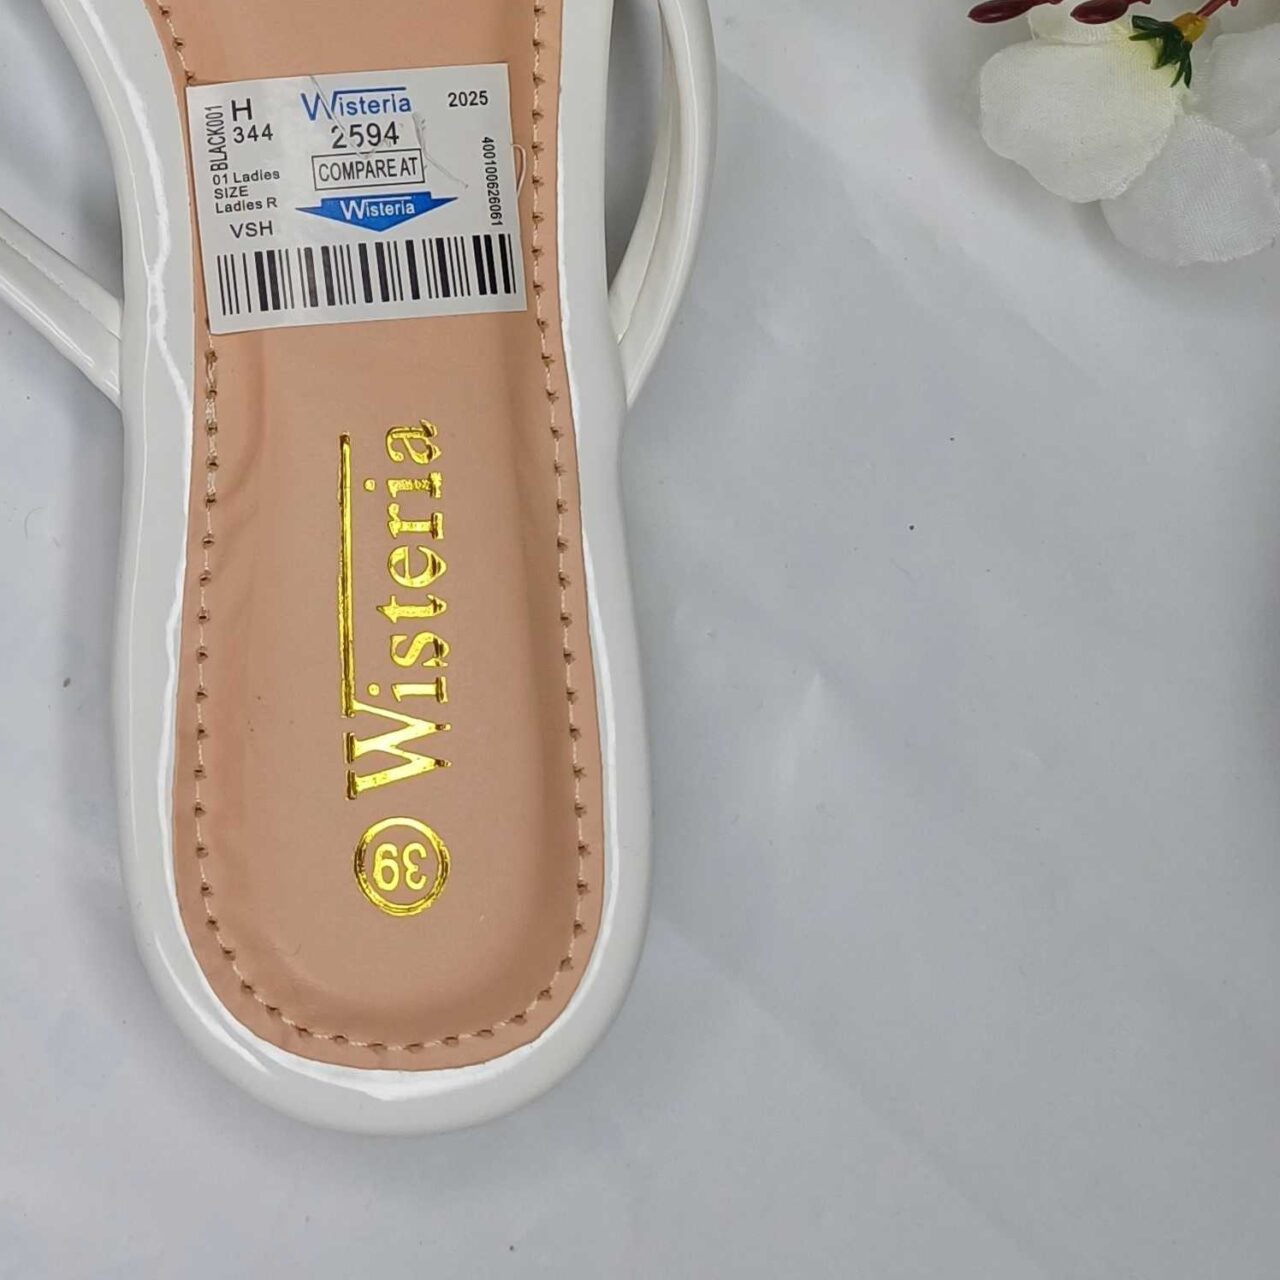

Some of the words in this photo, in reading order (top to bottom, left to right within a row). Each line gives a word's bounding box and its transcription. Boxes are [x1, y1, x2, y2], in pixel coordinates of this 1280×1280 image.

[230, 97, 253, 122] H
[300, 86, 412, 121] Wisteria
[447, 90, 490, 108] 2025
[204, 105, 229, 172] BLACK001
[232, 123, 274, 144] 344
[331, 121, 400, 150] 2594
[212, 173, 228, 186] 01
[233, 168, 280, 184] Ladies
[318, 158, 398, 182] COMPARE
[399, 157, 418, 177] AT
[481, 136, 504, 227] 400100626061
[214, 185, 250, 200] SIZE
[215, 199, 263, 214] Ladies
[266, 196, 279, 209] R
[340, 196, 416, 221] Wisteria
[229, 220, 274, 239] VSH
[338, 418, 452, 801] Wisteria
[372, 841, 428, 892] 39
